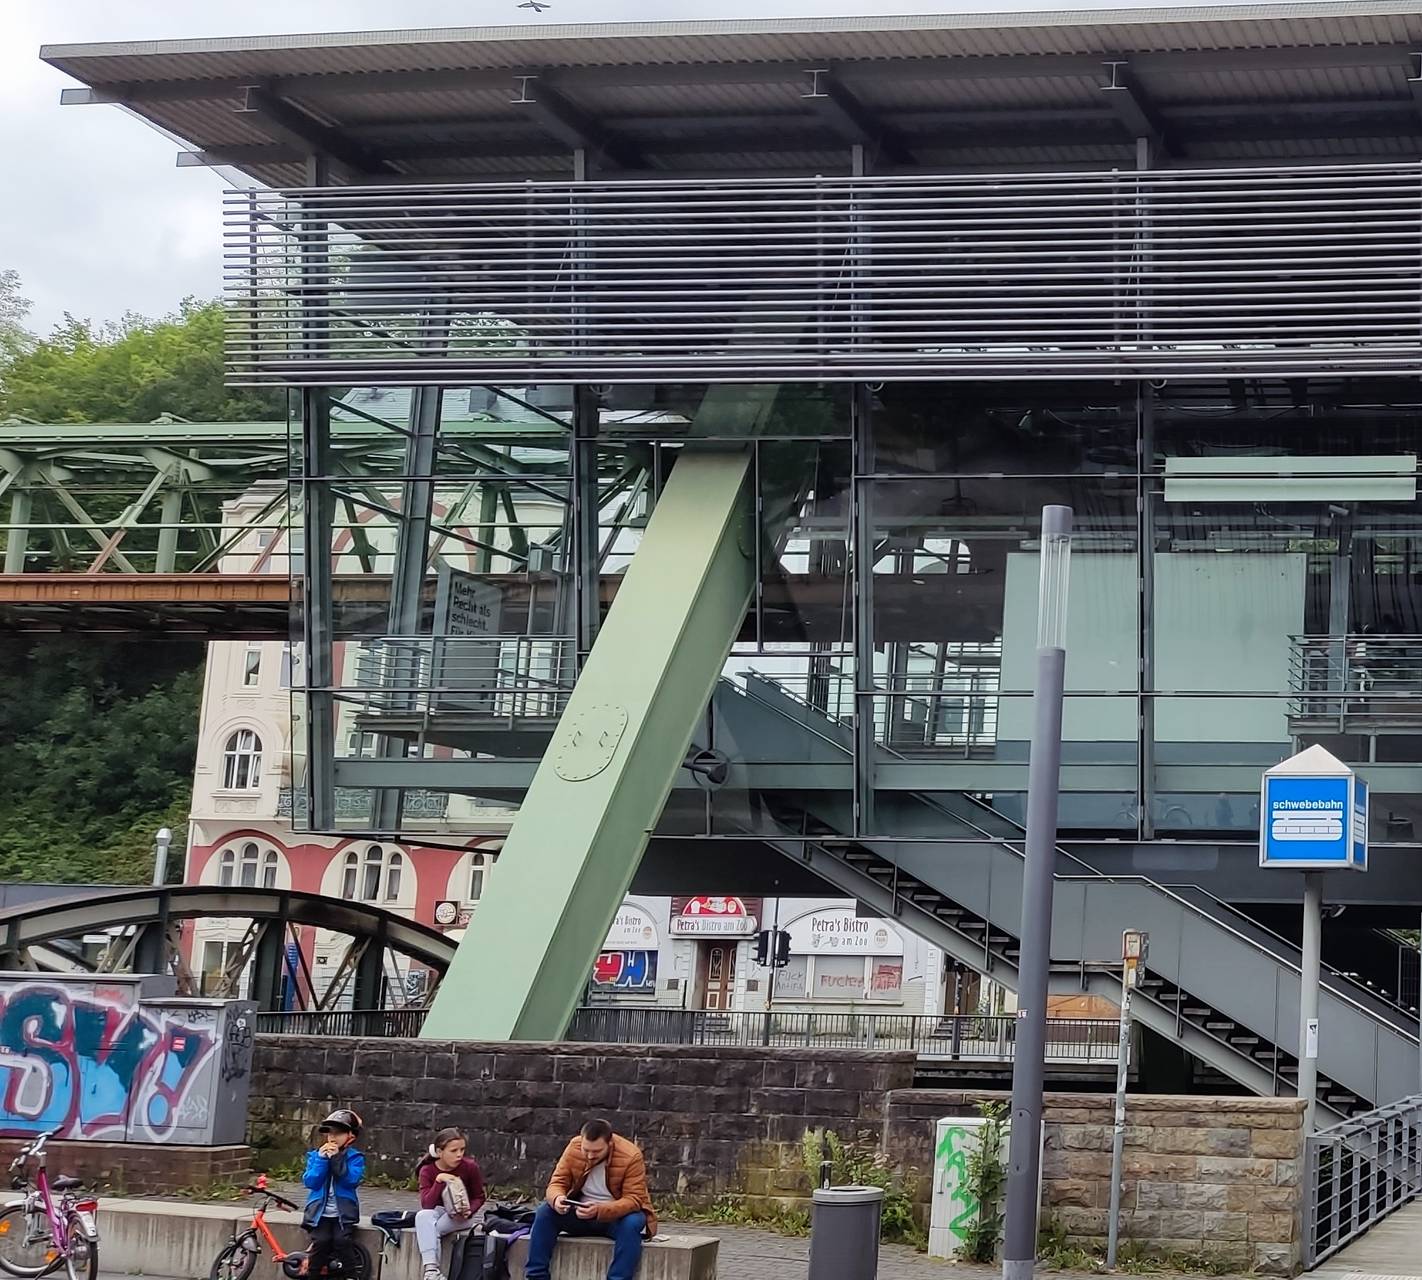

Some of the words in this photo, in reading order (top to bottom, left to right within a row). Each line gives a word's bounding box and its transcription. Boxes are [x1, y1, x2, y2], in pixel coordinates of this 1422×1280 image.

[1273, 799, 1344, 809] schwebebahn
[676, 919, 700, 931] Petra's
[811, 917, 841, 933] Petra's
[843, 917, 869, 933] Bistro
[841, 937, 853, 946] am
[855, 935, 868, 946] Zoo
